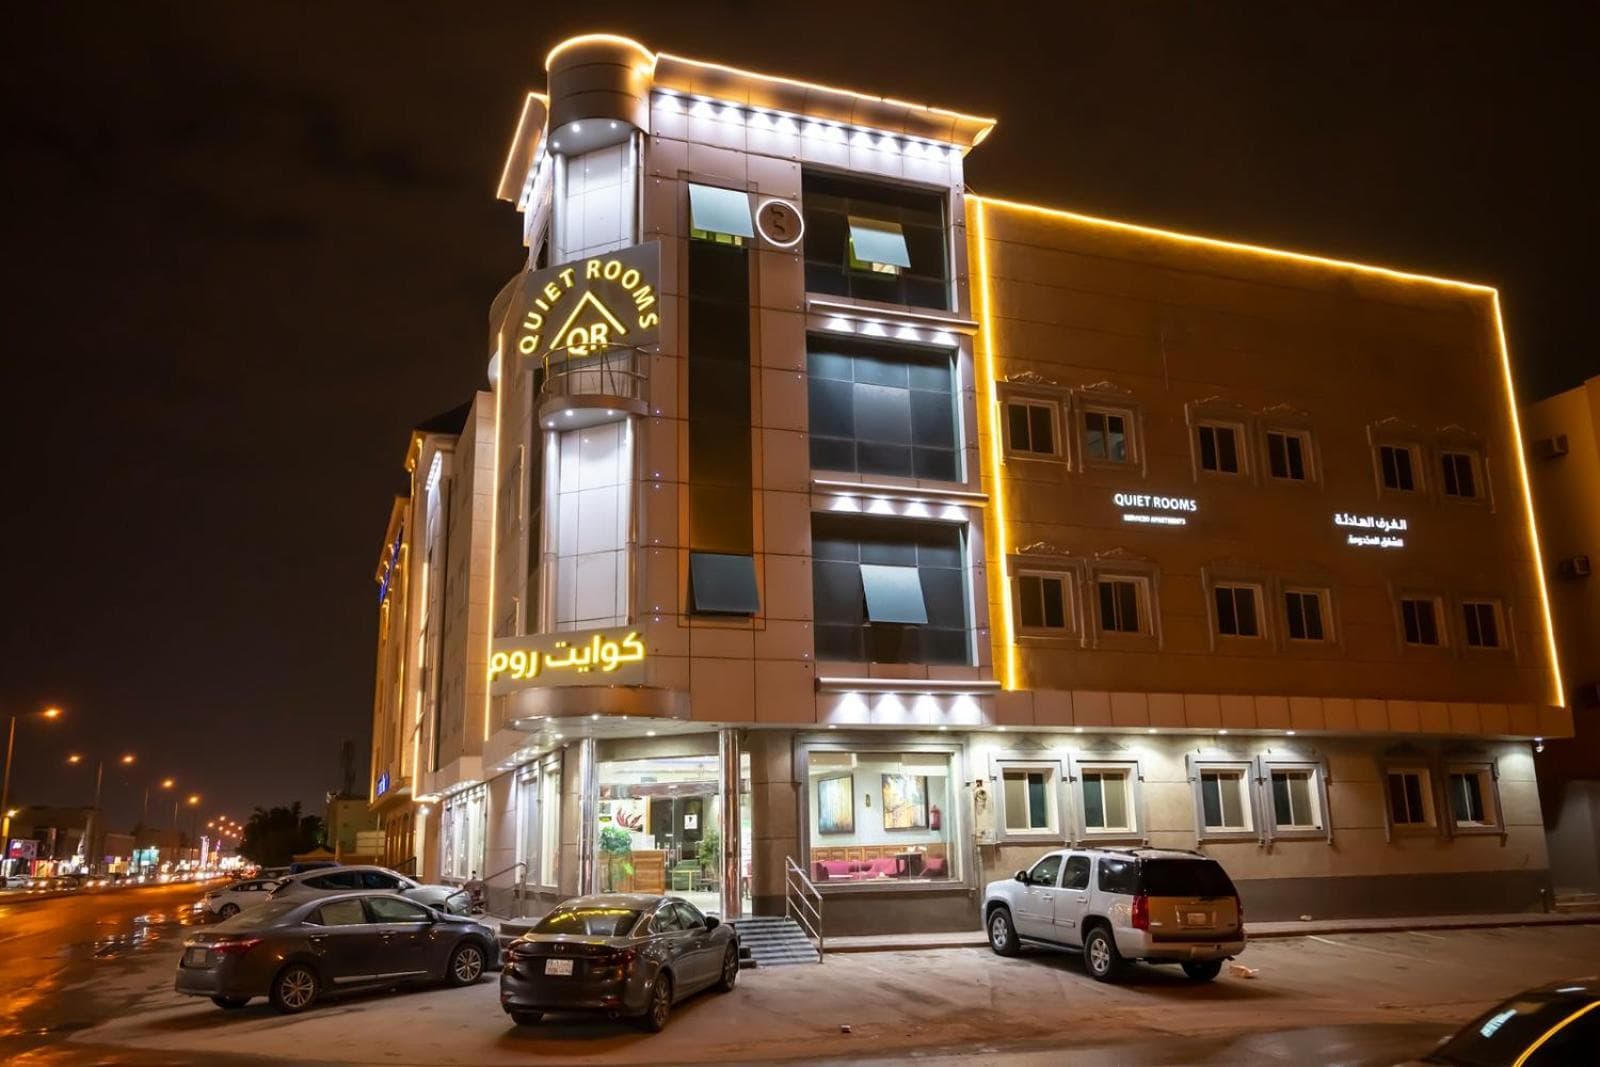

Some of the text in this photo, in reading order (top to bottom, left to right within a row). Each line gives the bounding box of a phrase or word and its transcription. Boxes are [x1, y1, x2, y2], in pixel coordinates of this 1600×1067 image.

[519, 259, 658, 354] QUIET ROOMS
[566, 322, 608, 356] QR
[1114, 493, 1197, 511] QUIET ROOMS
[489, 632, 645, 681] كوايت روم
